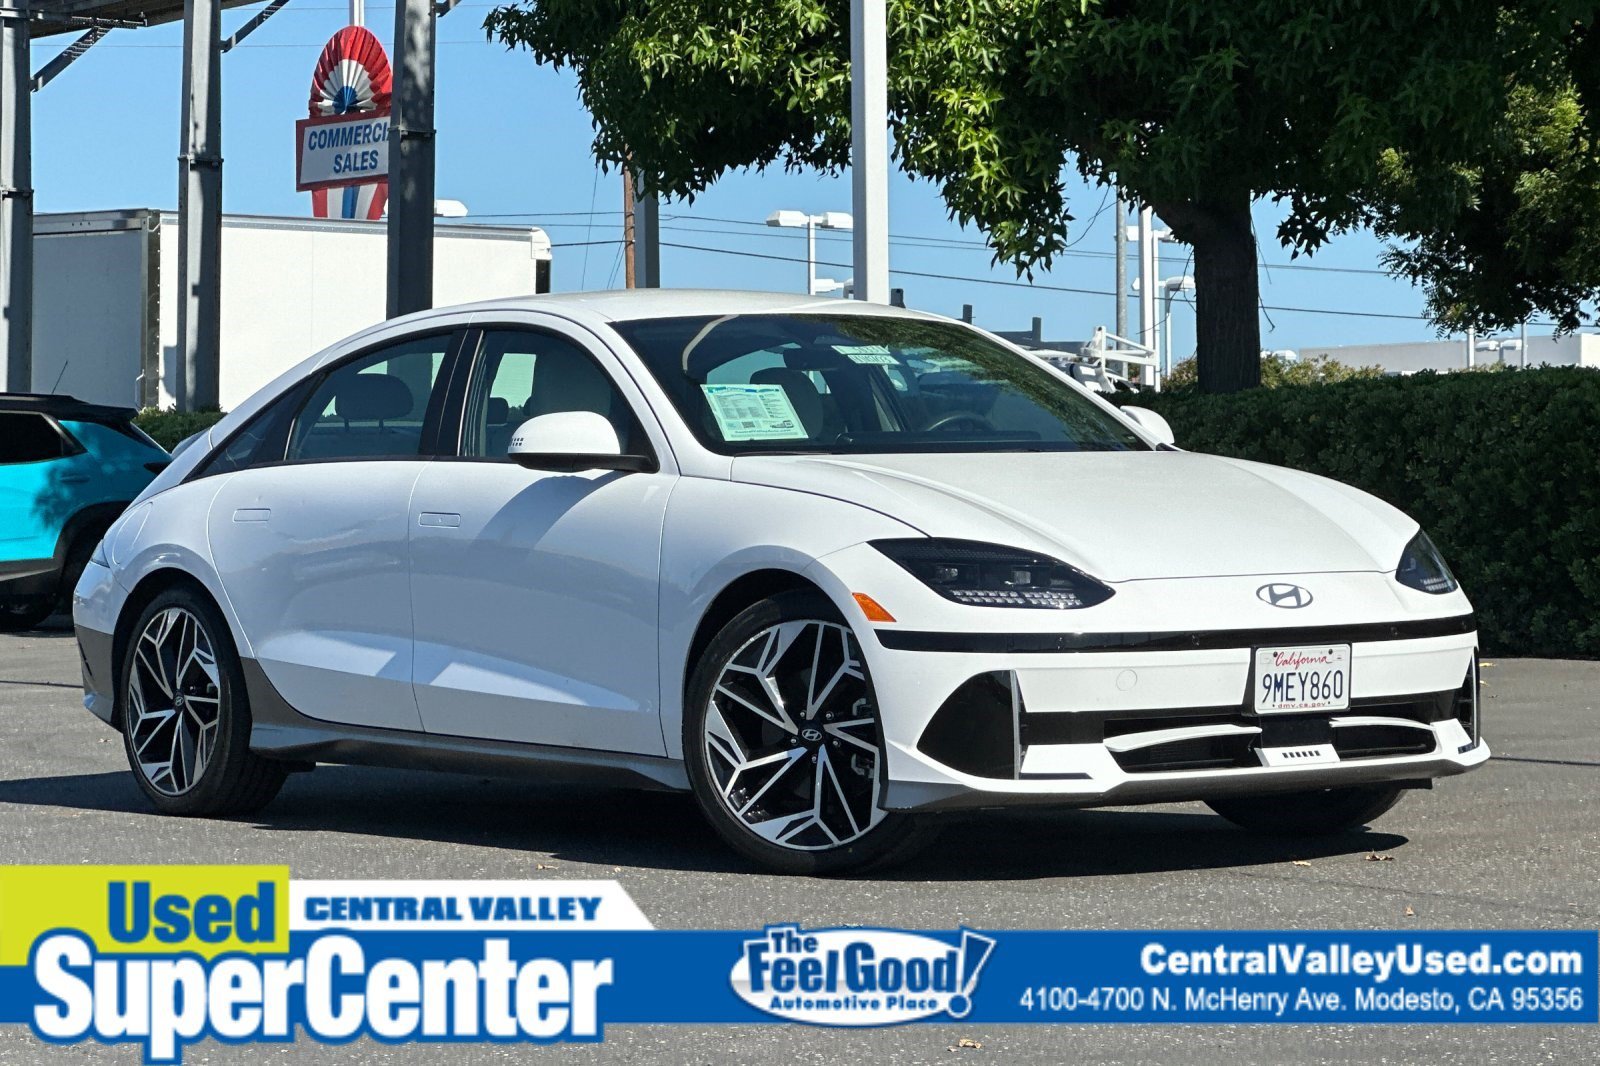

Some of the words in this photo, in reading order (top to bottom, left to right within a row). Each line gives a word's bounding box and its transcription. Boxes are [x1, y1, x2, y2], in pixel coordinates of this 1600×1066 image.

[308, 121, 390, 152] COMMERCI
[333, 150, 379, 174] SALES
[1275, 651, 1333, 670] California
[1262, 670, 1343, 704] 9MEY860
[1277, 701, 1326, 709] dmv.ca.gov
